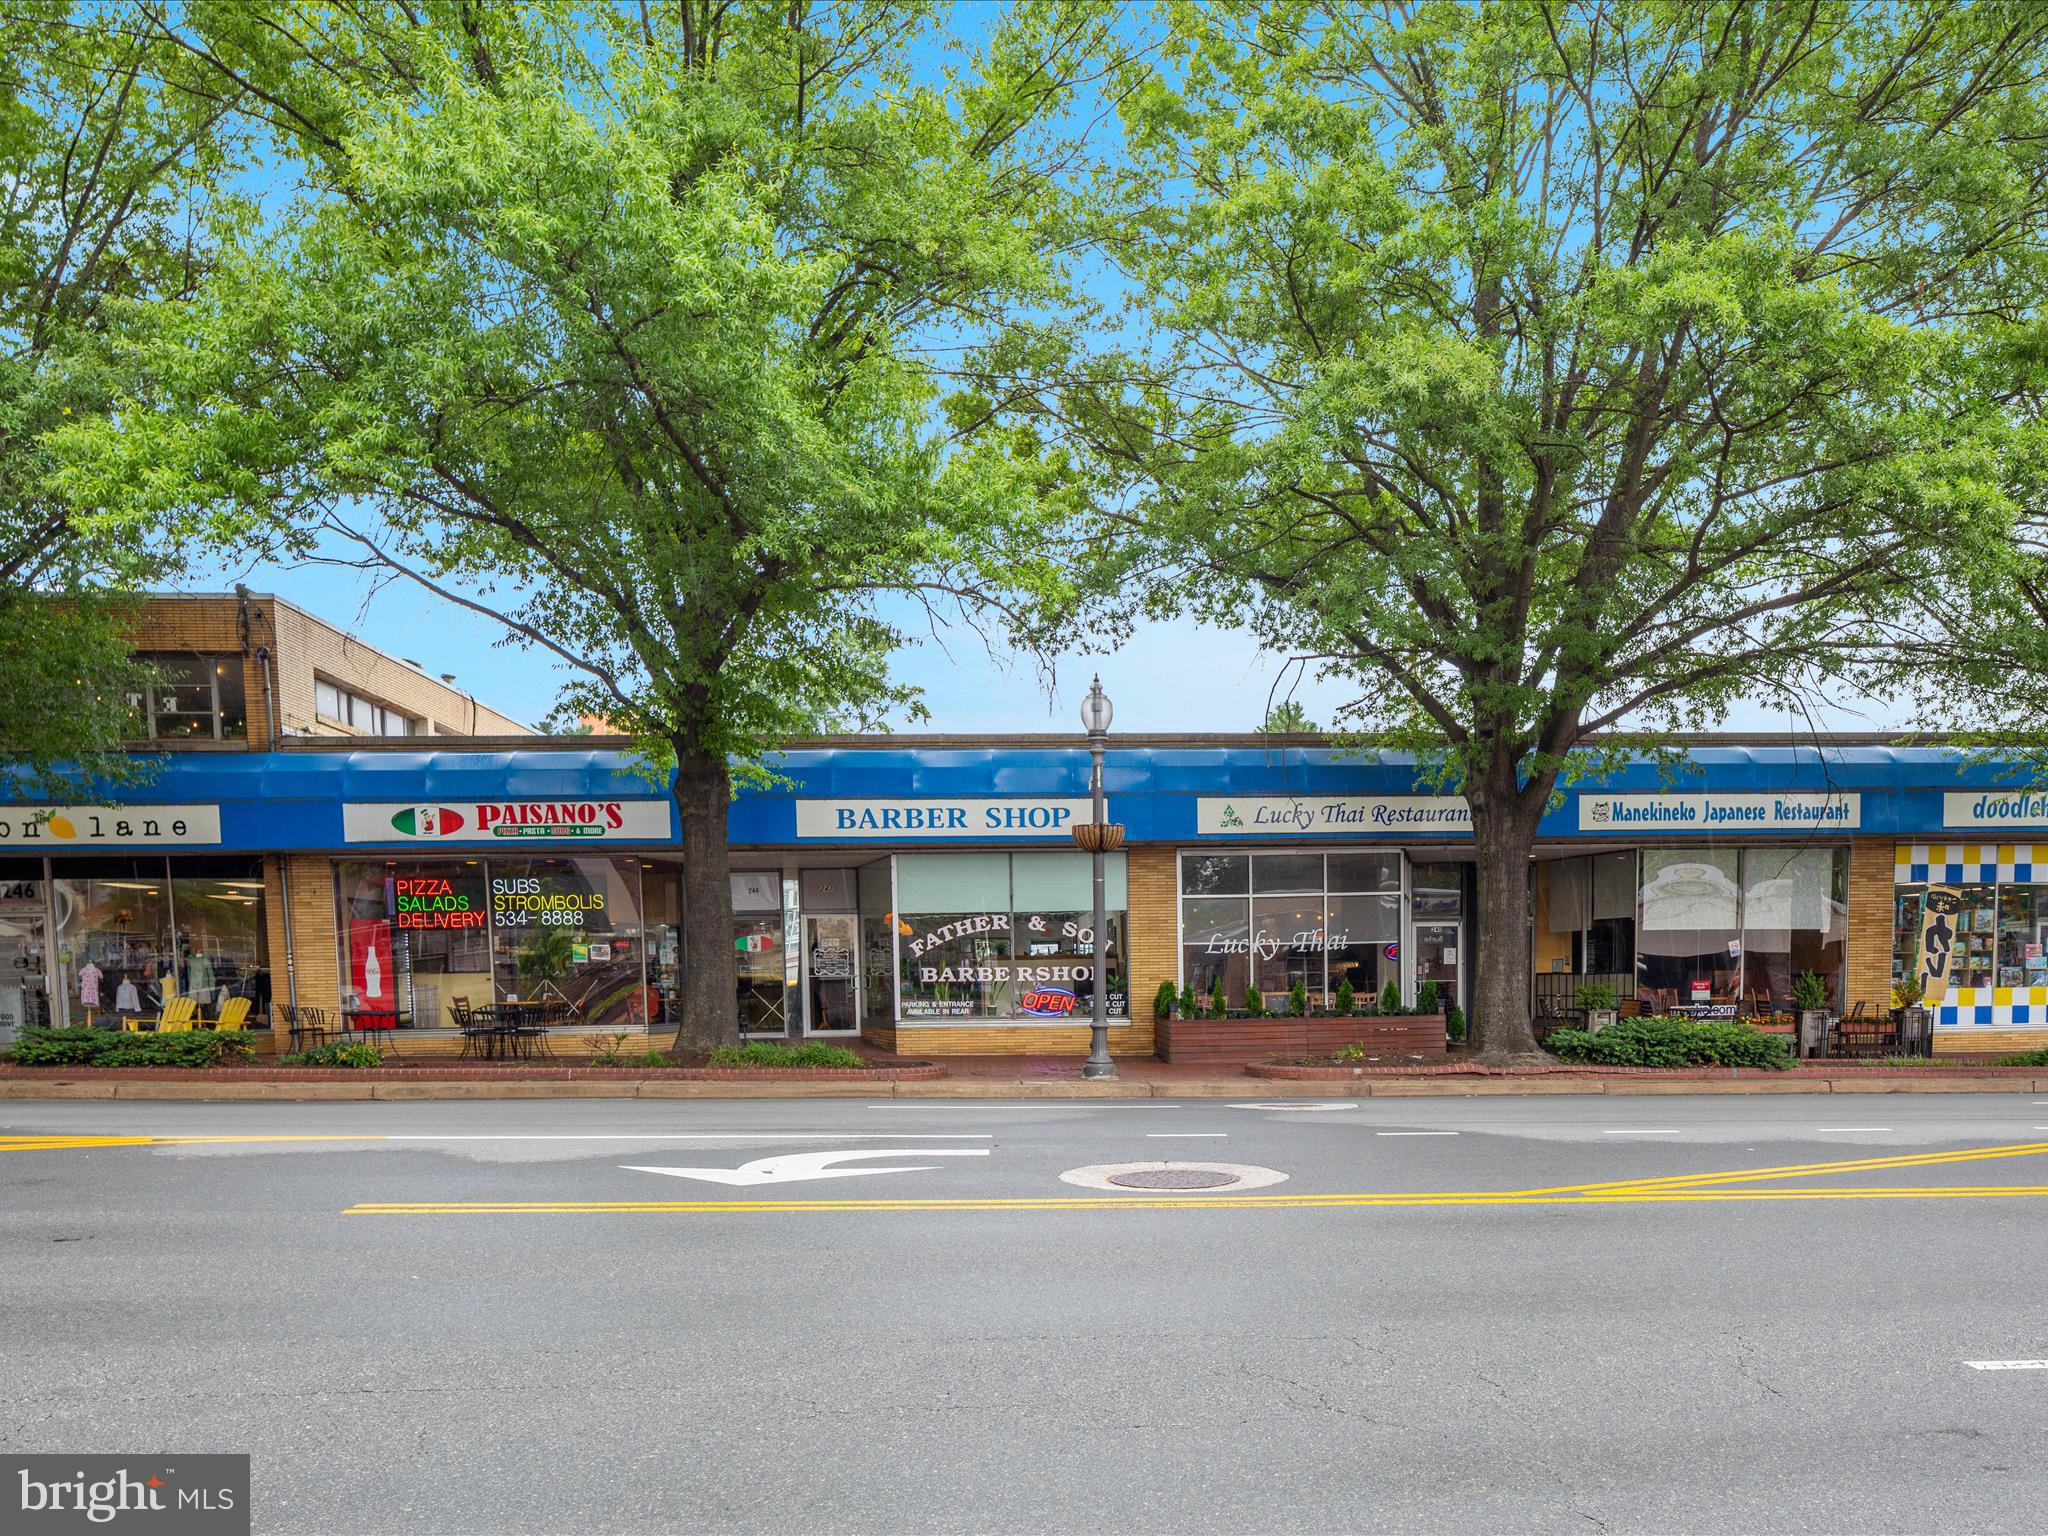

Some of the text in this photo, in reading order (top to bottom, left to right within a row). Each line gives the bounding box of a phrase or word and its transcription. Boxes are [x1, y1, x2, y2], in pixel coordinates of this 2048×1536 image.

[475, 802, 623, 831] PAISANO'S
[836, 806, 1071, 829] BARBER SHOP
[1253, 802, 1472, 829] Lucky Thai Restauran
[1612, 800, 1850, 824] Manekineko Japanese Restaurant
[89, 816, 188, 837] lane
[523, 827, 545, 835] PASTA
[396, 879, 453, 896] PIZZA
[492, 878, 541, 894] SUBS
[397, 895, 470, 912] SALADS
[493, 894, 605, 911] STROMBOLIS
[398, 911, 486, 928] DELIVERY
[909, 914, 1011, 957] FATHER
[1028, 915, 1046, 932] &
[1204, 928, 1349, 961] Lucky Thai
[938, 1000, 974, 1008] ENTRANCE
[1022, 991, 1077, 1012] OPEN
